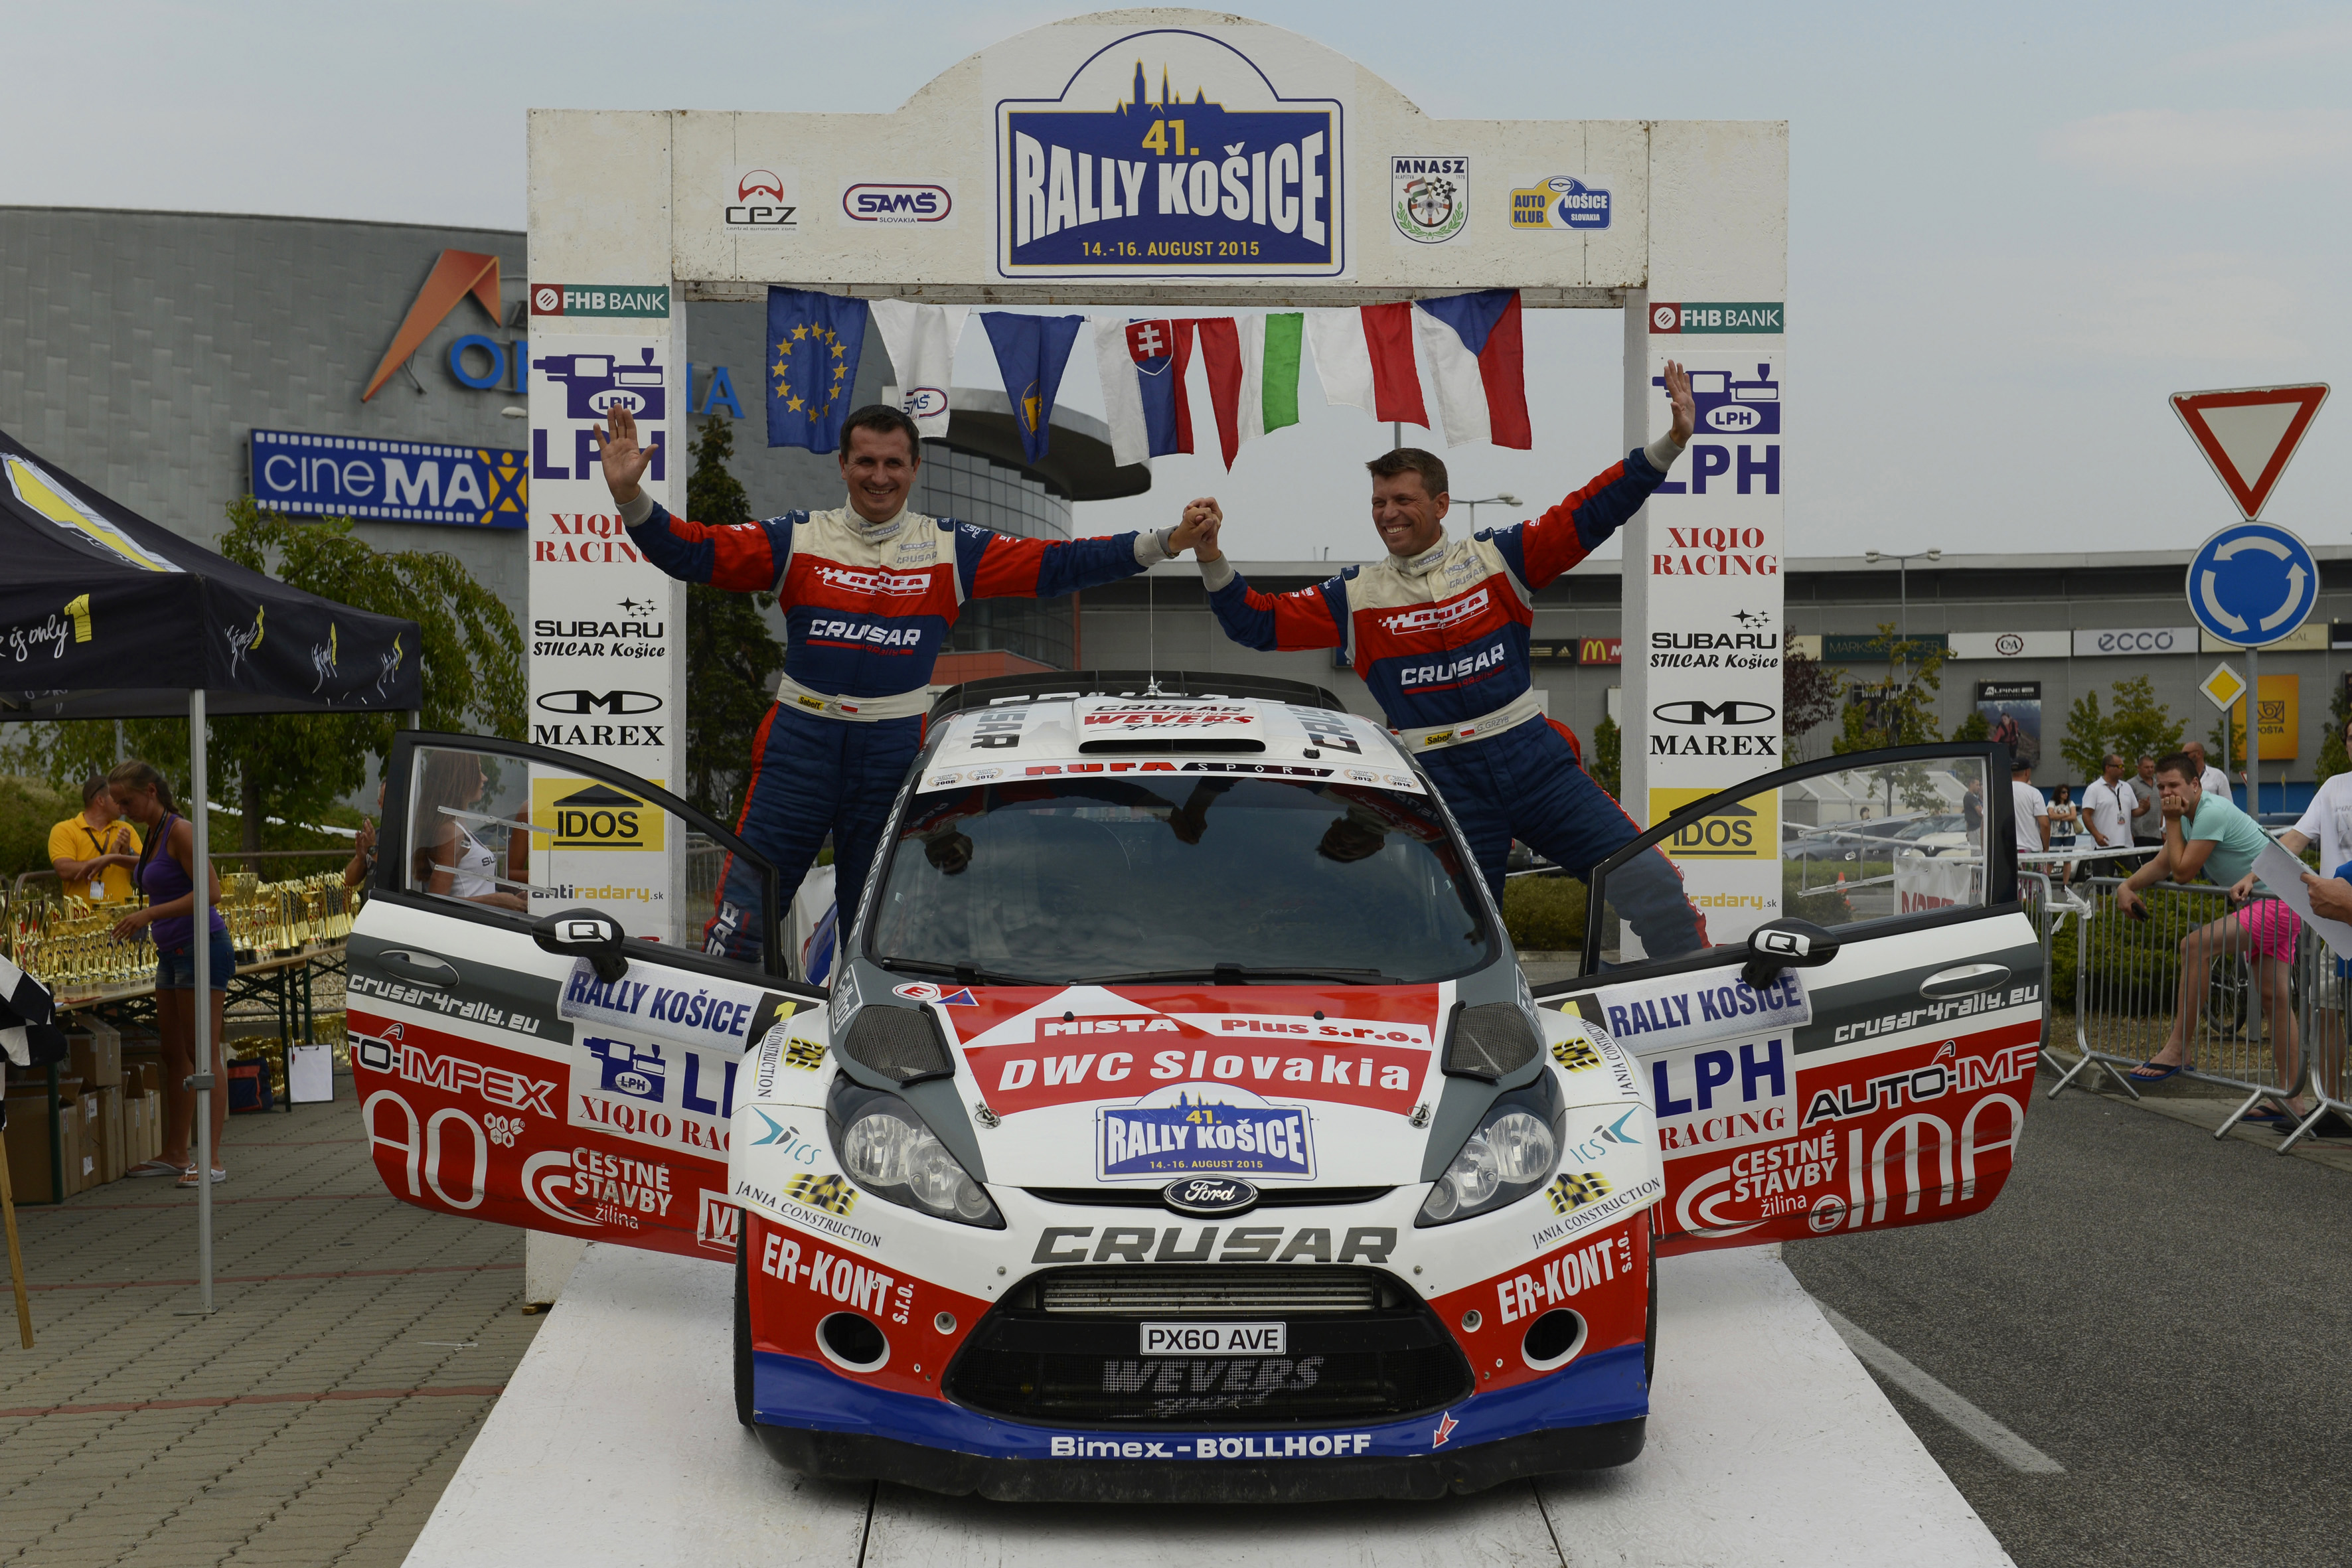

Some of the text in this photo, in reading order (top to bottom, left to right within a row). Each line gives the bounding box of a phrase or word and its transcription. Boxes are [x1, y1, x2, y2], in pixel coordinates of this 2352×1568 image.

[1142, 119, 1199, 155] 41.
[1395, 160, 1464, 173] MNASZ
[1016, 131, 1325, 247] RALLY KOŠICE
[1514, 195, 1545, 208] AUTO
[1564, 193, 1607, 209] KOŠICE
[858, 193, 937, 212] SAMŠ
[1514, 211, 1543, 223] KLUB
[1083, 241, 1259, 256] 14.-16. AUGUST 2015
[563, 292, 665, 311] FHB BANK
[1680, 309, 1780, 326] FHB BANK
[599, 396, 636, 410] LPH
[1715, 412, 1751, 425] LPH
[550, 513, 623, 538] XIQI
[1666, 527, 1764, 552] XIQIO
[897, 552, 937, 564] CRUSAR
[1651, 554, 1778, 576] RACING
[1449, 566, 1486, 588] CRUSAR
[29, 614, 68, 659] only
[64, 593, 92, 643] 1
[535, 620, 664, 638] SUBARU
[809, 619, 921, 646] CRUSAR
[533, 642, 665, 659] STILCAR Košice
[1652, 632, 1777, 649] SUBARU
[2001, 639, 2019, 650] C&A
[2098, 631, 2173, 652] ecco
[1401, 643, 1504, 685] CRUSAR
[1650, 654, 1778, 670] STILCAR Košice
[799, 696, 823, 710] Sabelt
[1085, 714, 1255, 726] WEVERS
[533, 725, 665, 746] MAREX
[1650, 736, 1777, 755] MAREX
[1026, 762, 1178, 775] RUFA
[1198, 763, 1321, 776] SPORT
[558, 811, 639, 838] IDOS
[1674, 819, 1753, 847] IDOS
[532, 884, 663, 903] antiradary.sk
[1686, 892, 1776, 910] radary.sk
[349, 973, 540, 1034] crusar4rally.eu
[568, 969, 650, 1017] RALLY
[649, 988, 752, 1037] KOŠICE
[1607, 975, 1802, 1038] RALLY KOŠICE
[1834, 984, 2039, 1044] crusar4rally.eu
[1044, 1019, 1422, 1044] MISTA Plus s.r.o.
[758, 1035, 782, 1098] CONSTRUCTION
[998, 1050, 1411, 1092] DWC Slovakia
[1612, 1062, 1640, 1096] JANIA
[1652, 1039, 1786, 1118] LPH
[620, 1075, 646, 1091] LPH
[579, 1094, 672, 1138] XIQIO
[1186, 1110, 1221, 1124] 41.
[1108, 1116, 1304, 1166] RALLY KOŠICE
[1659, 1107, 1786, 1151] RACING
[1570, 1138, 1605, 1164] ICS
[1733, 1129, 1836, 1178] CESTNÉ
[572, 1147, 670, 1192] CESTNÉ
[1735, 1158, 1839, 1203] STAVBY
[574, 1171, 673, 1216] STAVBY
[1185, 1180, 1236, 1202] Ford
[595, 1202, 639, 1229] žilina
[736, 1181, 777, 1208] JANIA
[781, 1202, 882, 1248] CONSTRUCTION
[1532, 1177, 1661, 1249] JANIA CONSTRUCTION
[1761, 1194, 1807, 1218] žilina
[1031, 1226, 1397, 1264] CRUSAR
[762, 1232, 914, 1325] ER-KONT s.r.o.
[1497, 1231, 1632, 1325] ER-KONT s.r.o.
[1148, 1329, 1279, 1351] PX60 AVE
[1103, 1356, 1324, 1393] WEVERS
